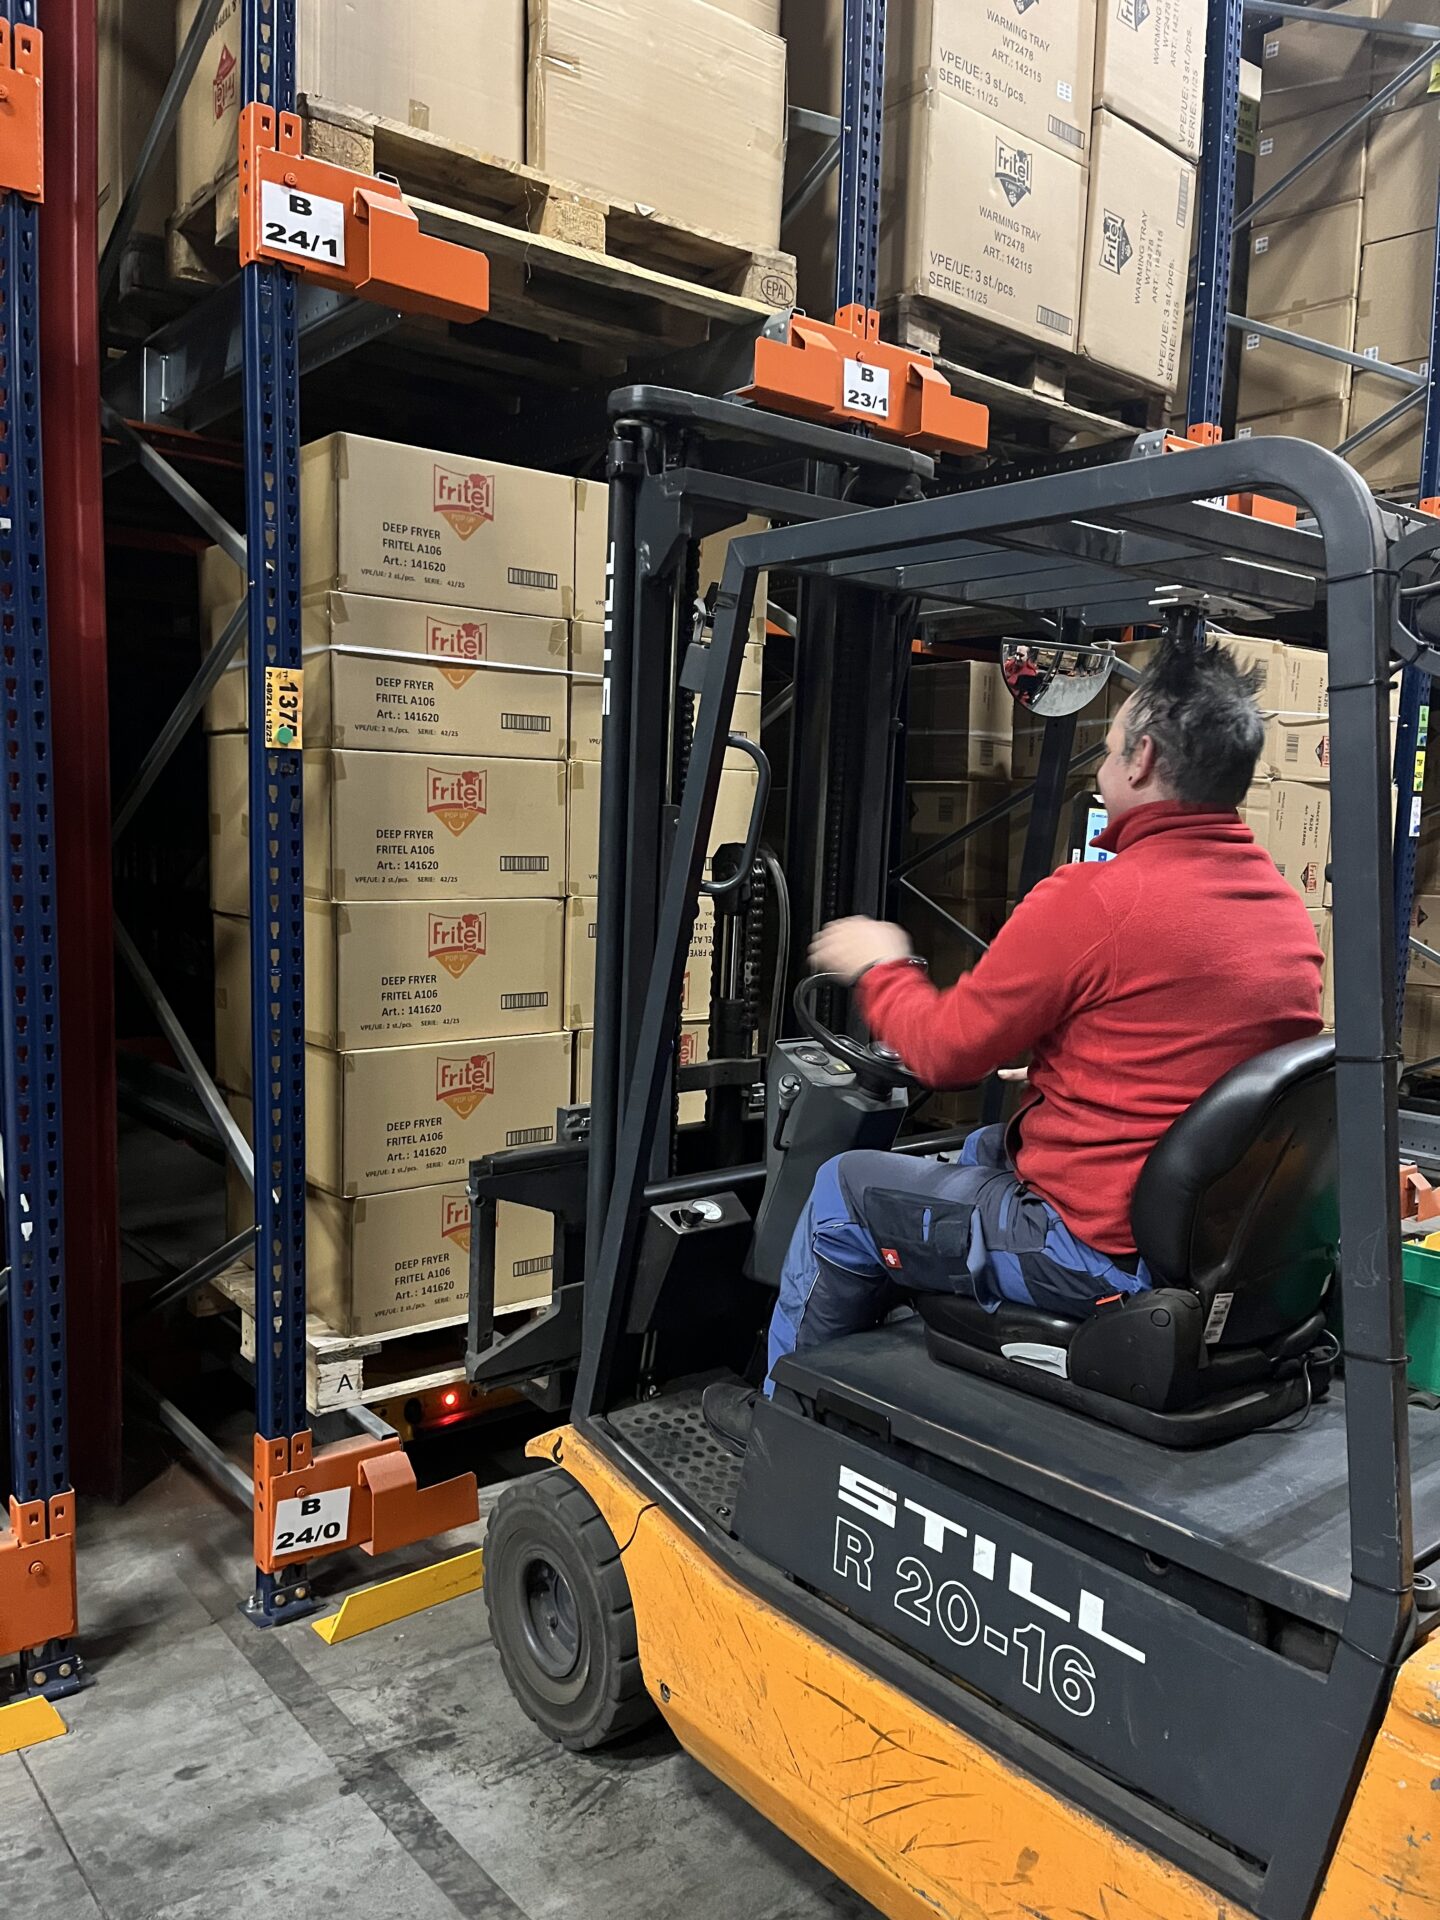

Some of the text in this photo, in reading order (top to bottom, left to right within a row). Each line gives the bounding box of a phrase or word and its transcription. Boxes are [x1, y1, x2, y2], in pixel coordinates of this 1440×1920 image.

[1121, 0, 1134, 23] Fri
[986, 8, 1050, 52] WARMING TRAY
[1152, 7, 1163, 65] WARMING
[1162, 2, 1172, 48] WT2478
[1002, 35, 1034, 61] WT2478
[939, 47, 1026, 104] VPE/UE: 3 st./pcs.
[1015, 60, 1042, 83] 142115
[938, 68, 999, 108] SERIE: 11/25
[1187, 69, 1199, 150] SERIE: 11/25
[998, 146, 1029, 181] Fritel
[289, 194, 312, 216] B
[979, 205, 1042, 244] WARMING TRAY
[265, 222, 337, 258] 24/1
[994, 230, 1025, 253] WT2478
[1104, 216, 1120, 267] Fritel
[1006, 255, 1033, 274] 142115
[1134, 209, 1148, 305] WARMING TRAY
[1144, 239, 1155, 285] WT2478
[929, 250, 1017, 298] VPE/UE: 3 st./pcs.
[766, 279, 790, 302] EPAL
[928, 271, 988, 305] SERIE: 11/25
[1157, 317, 1169, 377] VPE/UE:
[1163, 309, 1170, 318] 3
[1166, 301, 1180, 381] SERIE: 11/25
[861, 367, 874, 382] B
[848, 389, 887, 411] 23/1
[439, 475, 490, 507] Fritel
[382, 521, 441, 540] DEEP FRYER
[382, 538, 442, 556] FRITEL A106
[383, 555, 446, 573] Art.: 141620
[432, 627, 482, 655] Fritel
[376, 676, 434, 691] DEEP FRYER
[376, 693, 435, 707] FRITEL A106
[354, 723, 380, 732] VPE/UE:
[376, 709, 439, 723] Art.: 141620
[432, 777, 482, 801] Fritel
[376, 829, 433, 840] DEEP FRYER
[376, 845, 435, 855] FRITEL A106
[376, 861, 439, 870] Art.: 141620
[433, 920, 482, 944] Fritel
[690, 949, 707, 957] FRYE
[381, 974, 437, 986] DEEP FRYER
[381, 989, 438, 1001] FRITEL A106
[381, 1004, 442, 1017] Art.: 141620
[360, 1023, 385, 1031] VPE/UE:
[441, 1061, 490, 1088] Fritel
[386, 1116, 442, 1132] DEEP FRYER
[386, 1131, 443, 1147] FRITEL A106
[386, 1145, 447, 1163] Art.: 141620
[365, 1169, 390, 1178] VPE/UE:
[446, 1201, 468, 1225] Fri
[394, 1252, 450, 1272] DEEP FRYER
[394, 1266, 451, 1286] FRITEL A106
[395, 1280, 455, 1301] Art.: 141620
[456, 1292, 469, 1300] 42/2
[336, 1373, 353, 1394] A
[301, 1498, 321, 1516] B
[275, 1521, 341, 1551] 24/0
[838, 1464, 1146, 1664] STILL
[833, 1515, 1096, 1717] R 20-16
